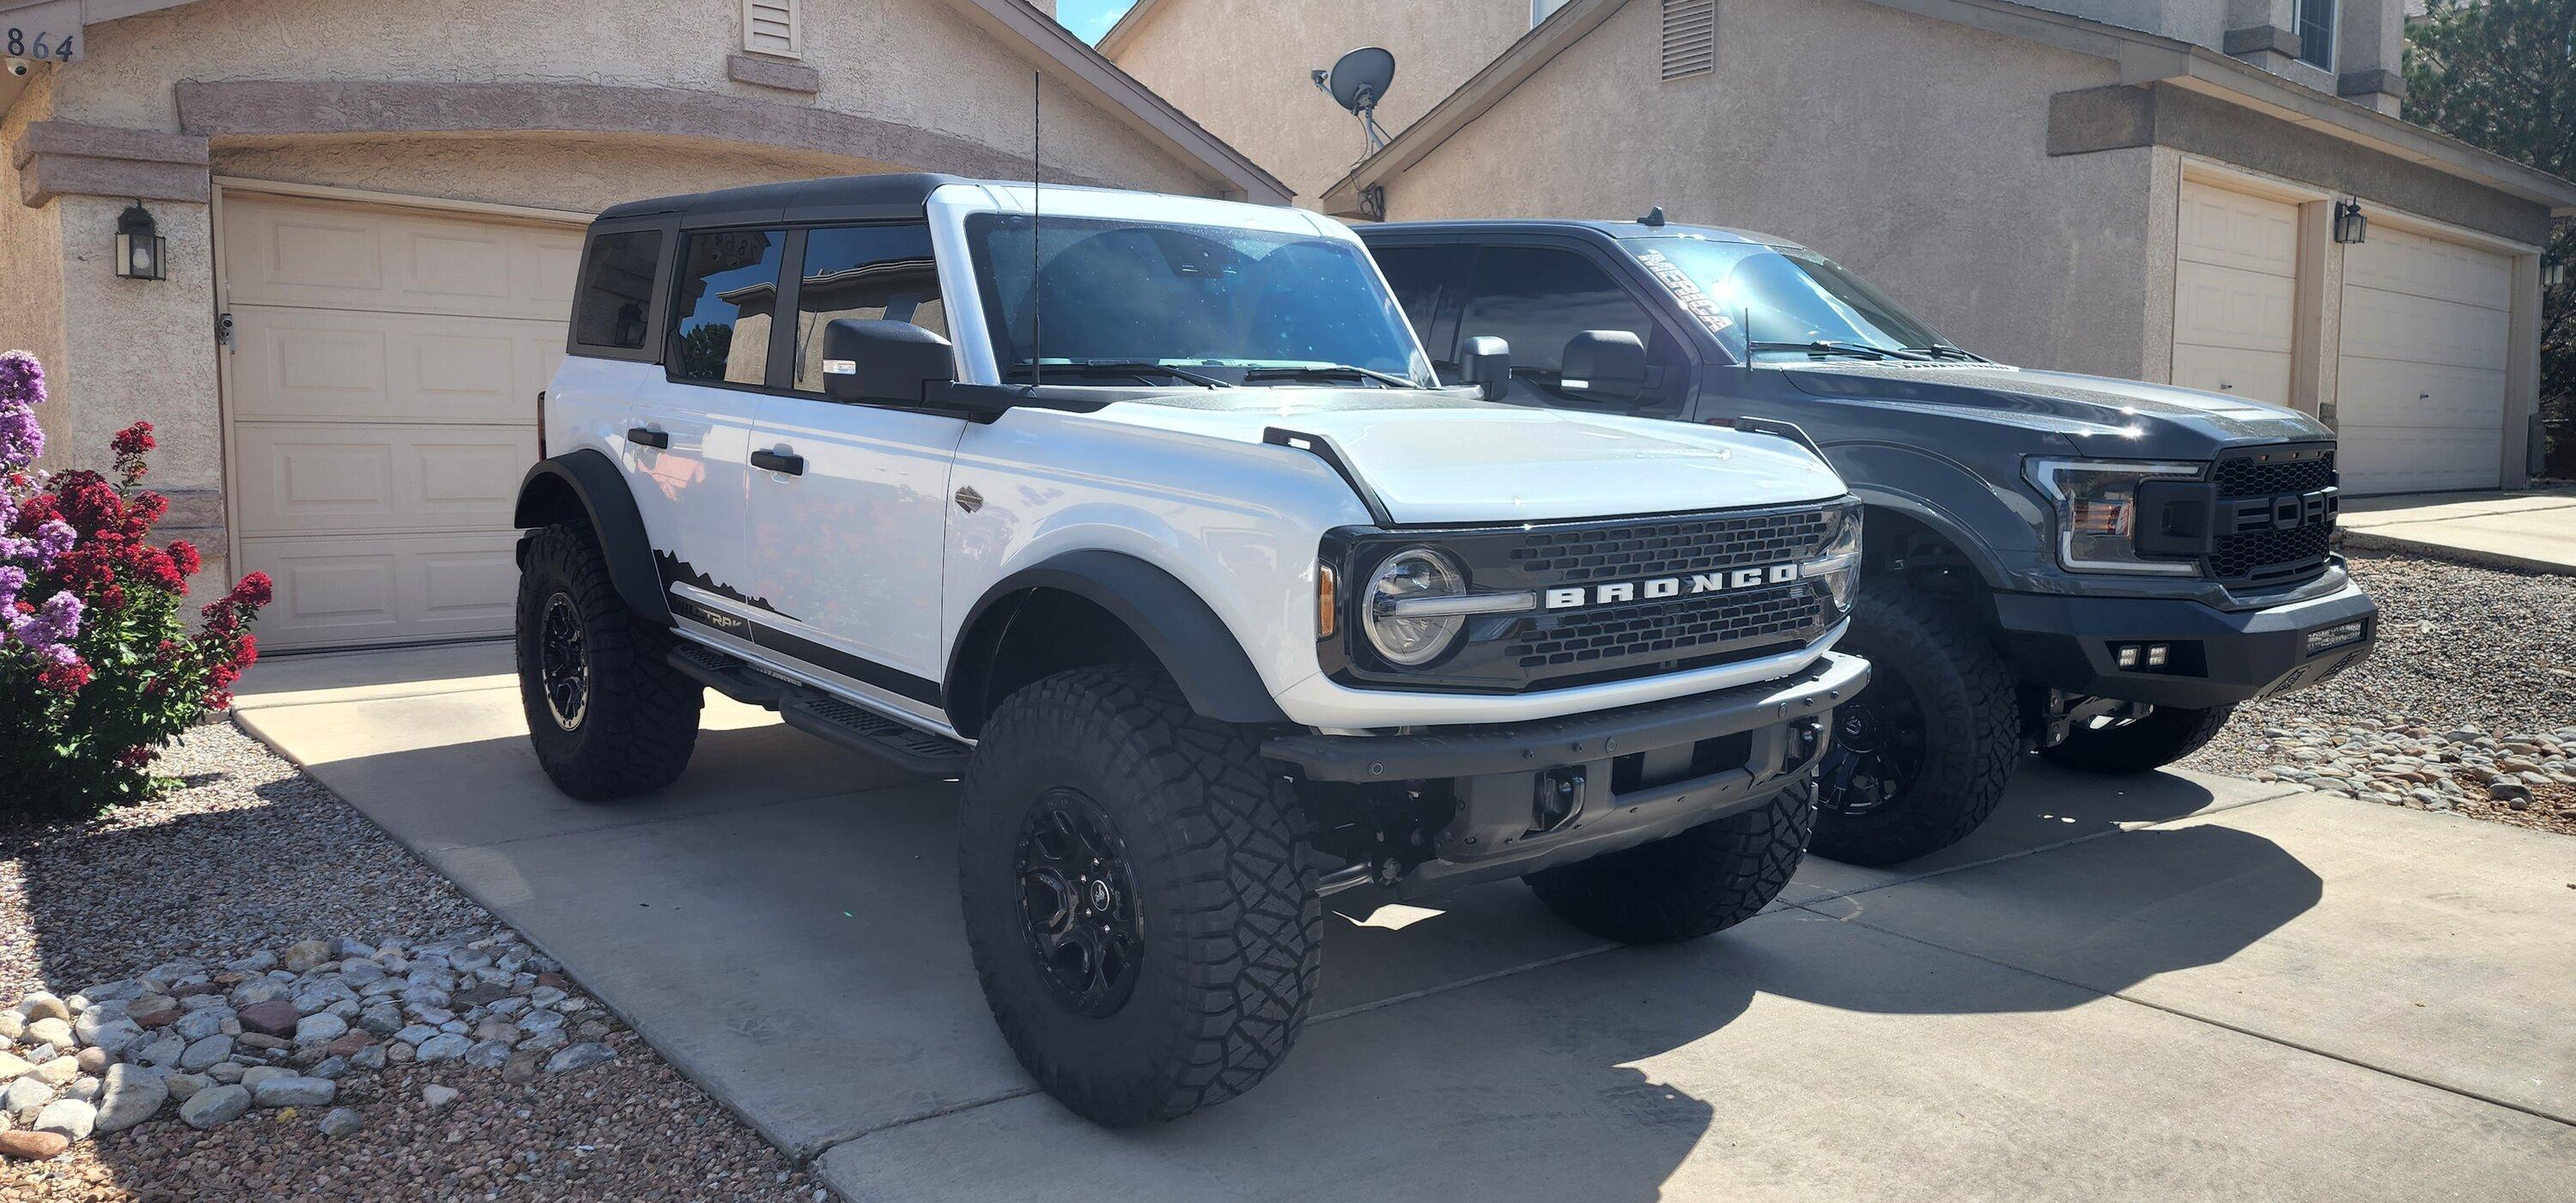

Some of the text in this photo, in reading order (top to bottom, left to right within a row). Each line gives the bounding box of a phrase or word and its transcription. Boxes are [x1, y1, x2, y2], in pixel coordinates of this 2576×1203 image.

[9, 27, 74, 62] 864
[2235, 486, 2338, 534] FORD
[1546, 563, 1798, 609] BRONCO
